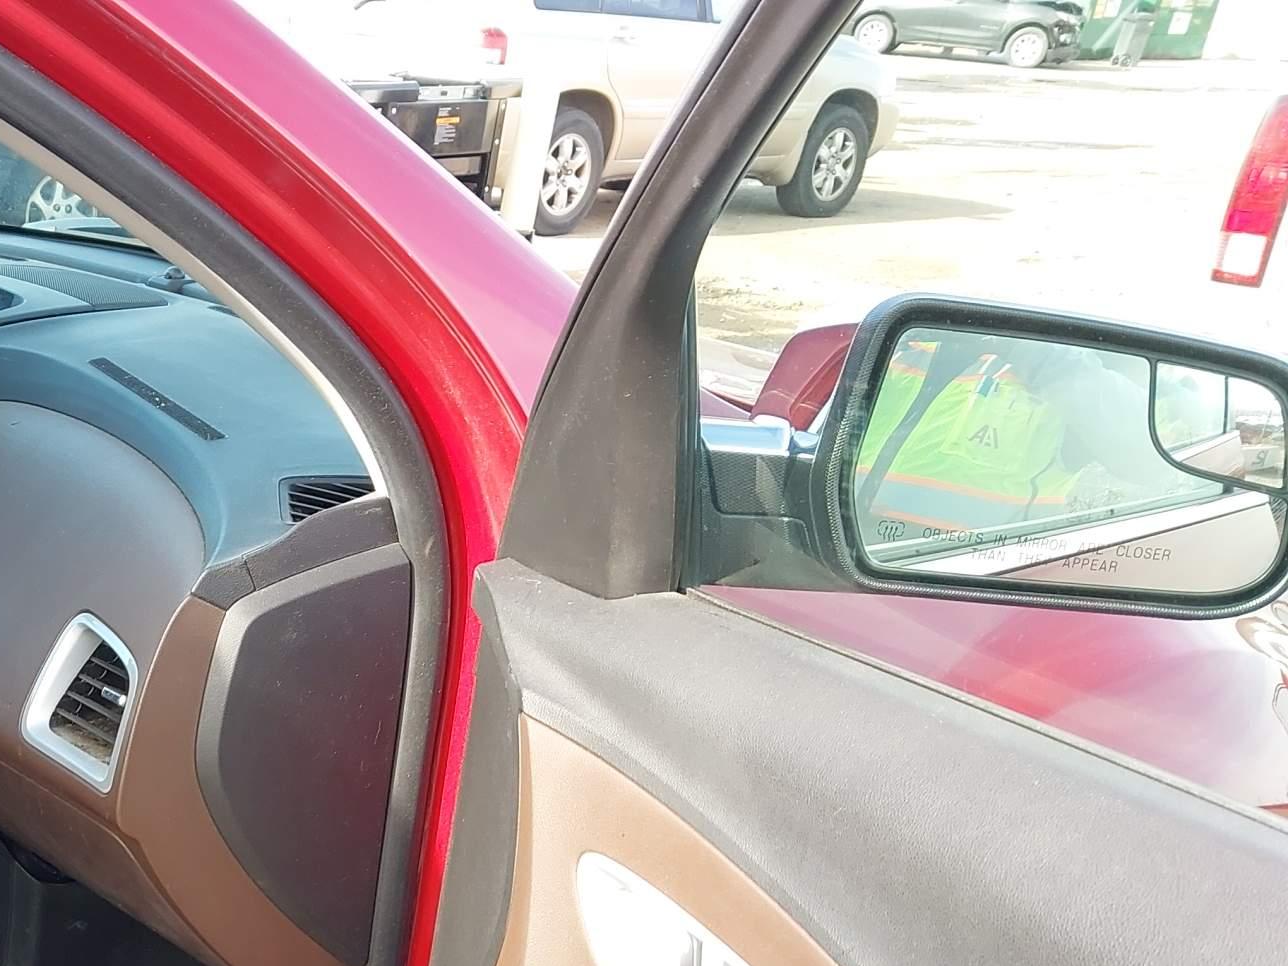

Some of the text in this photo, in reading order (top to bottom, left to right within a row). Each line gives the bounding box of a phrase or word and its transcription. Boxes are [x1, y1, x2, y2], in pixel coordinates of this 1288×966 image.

[922, 527, 1172, 561] OBJECTS IN MIRROR ARE CLOSER
[970, 547, 1006, 562] THAN
[1062, 558, 1119, 573] APPEAR
